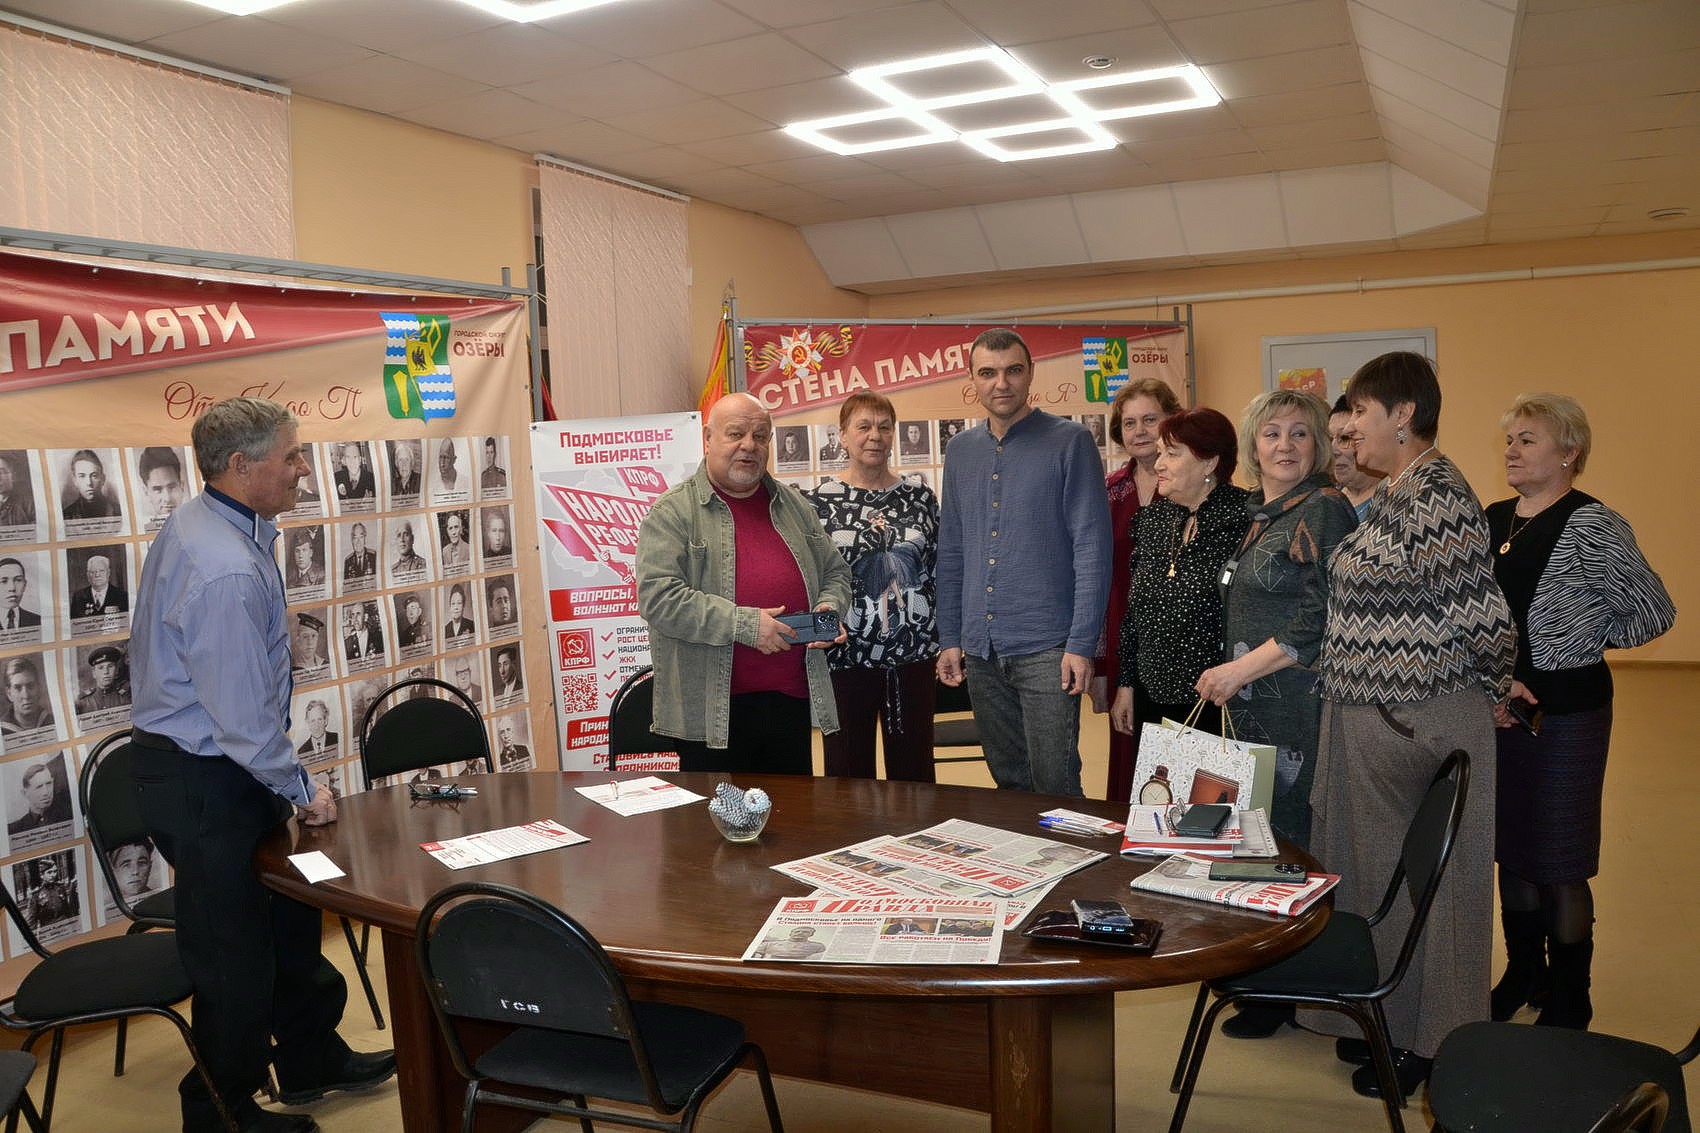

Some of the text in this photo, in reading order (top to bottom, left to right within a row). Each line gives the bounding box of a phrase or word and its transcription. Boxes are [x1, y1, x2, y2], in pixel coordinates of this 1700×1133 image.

[0, 302, 256, 373] ПАМЯТИ
[453, 338, 504, 358] ОЗЁРЫ
[1131, 351, 1169, 364] ОЗЁРЫ
[759, 366, 870, 410] СТЕНА
[624, 467, 660, 488] КПРФ
[569, 587, 634, 604] ВОПРОСЫ,
[573, 603, 625, 616] ВОЛНУЮТ
[617, 636, 636, 644] РОСТ
[564, 656, 591, 666] КПРФ
[620, 656, 636, 664] ЖКХ
